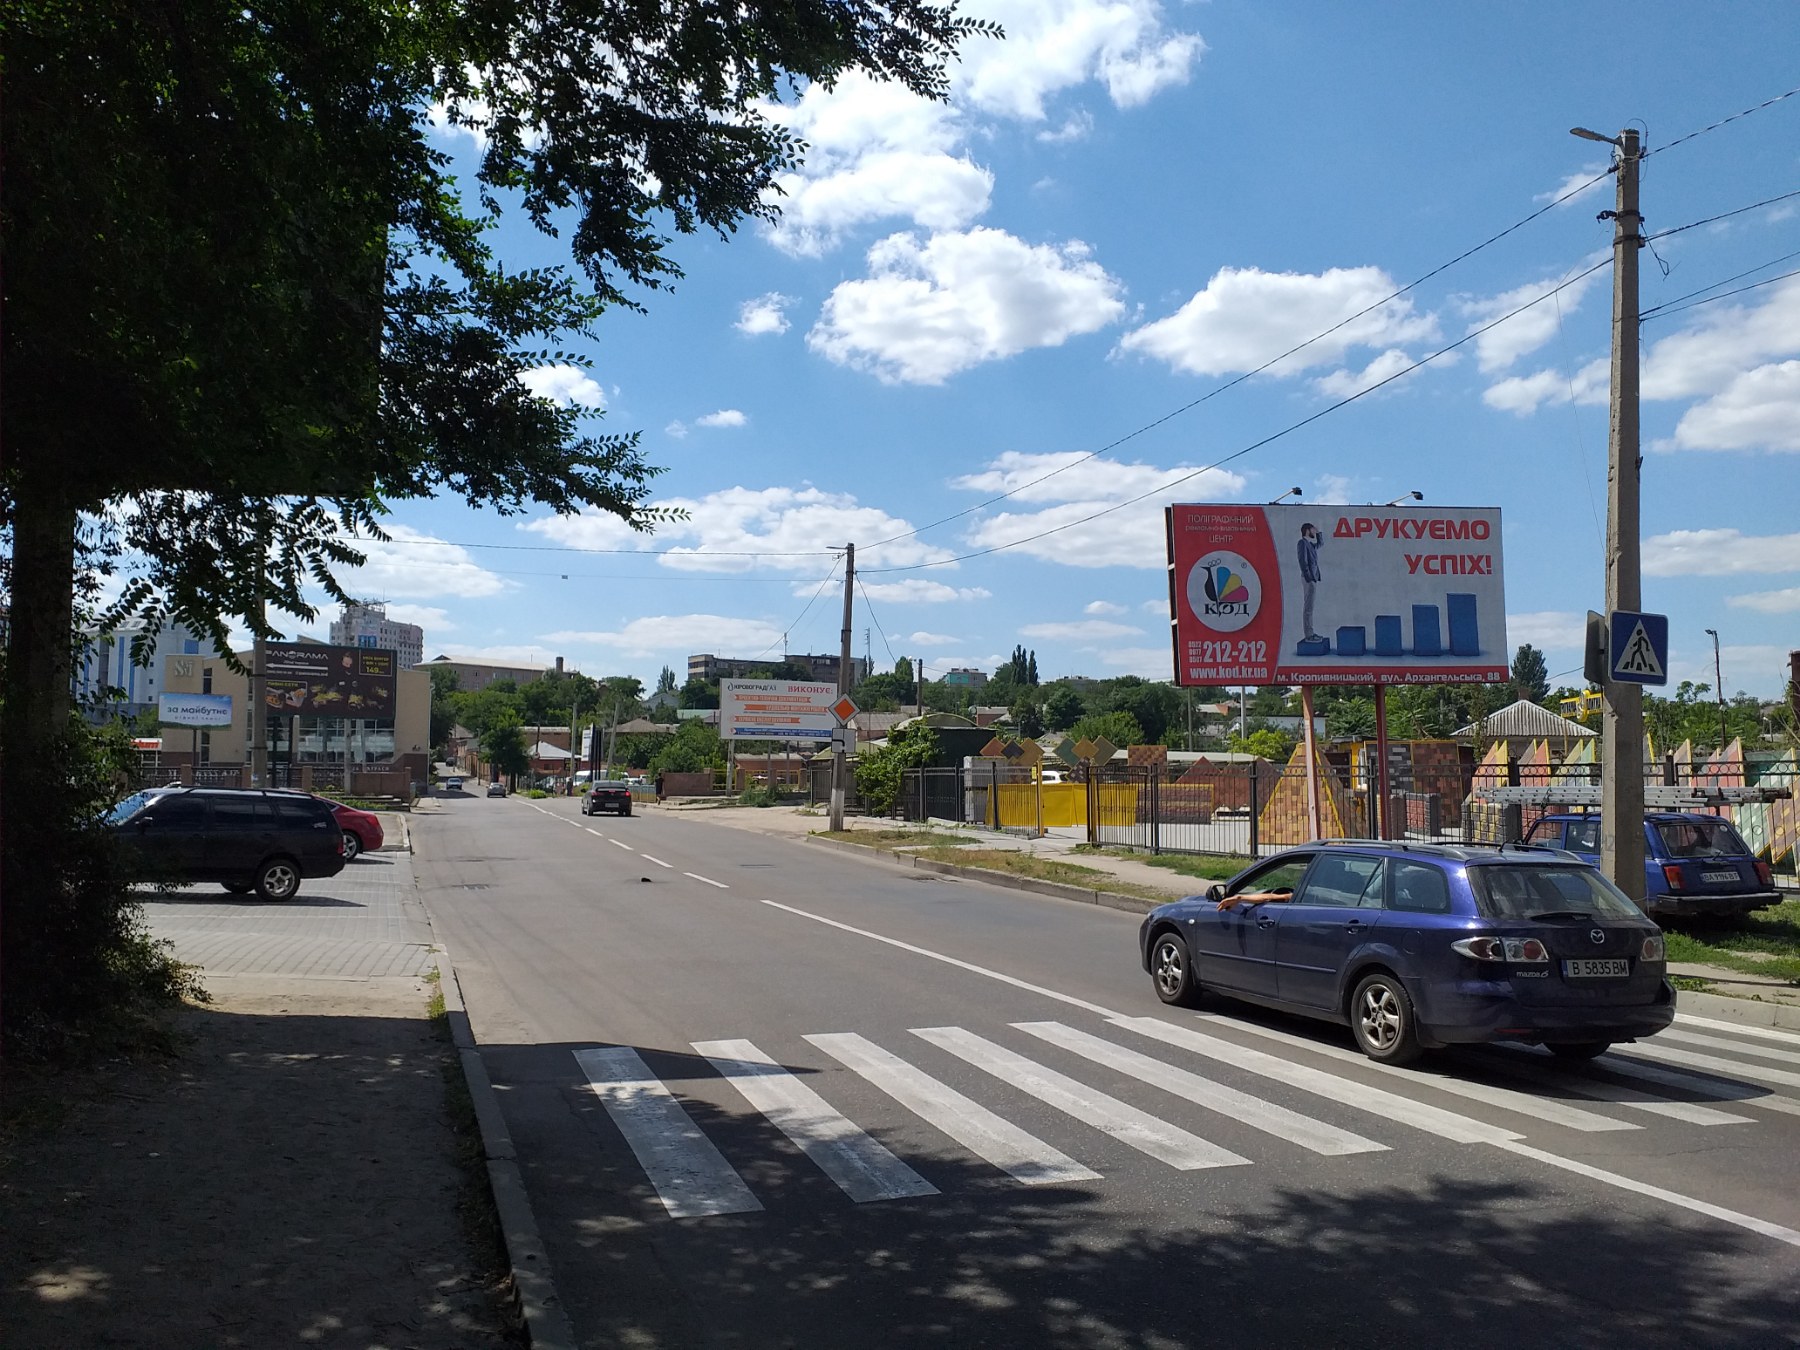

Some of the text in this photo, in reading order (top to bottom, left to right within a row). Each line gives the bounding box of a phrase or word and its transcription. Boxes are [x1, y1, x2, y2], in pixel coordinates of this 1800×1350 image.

[1187, 514, 1254, 524] ПОЛІГРАФІЧНИЙ
[1333, 517, 1491, 540] ДРУКУЄМО
[1208, 534, 1234, 543] ЦЕНТР
[1404, 554, 1493, 575] УСПІХ!
[1204, 602, 1250, 617] КОД
[1202, 640, 1267, 663] 212-212
[1189, 665, 1268, 679] www.kod.kr.ua
[1290, 671, 1377, 683] Кропивницький,
[1380, 674, 1403, 683] вул.
[1404, 672, 1485, 683] Архангельська,
[1487, 672, 1500, 681] 88
[787, 686, 833, 694] ВИКОНУЄ:
[1572, 961, 1628, 975] B 5835 BM
